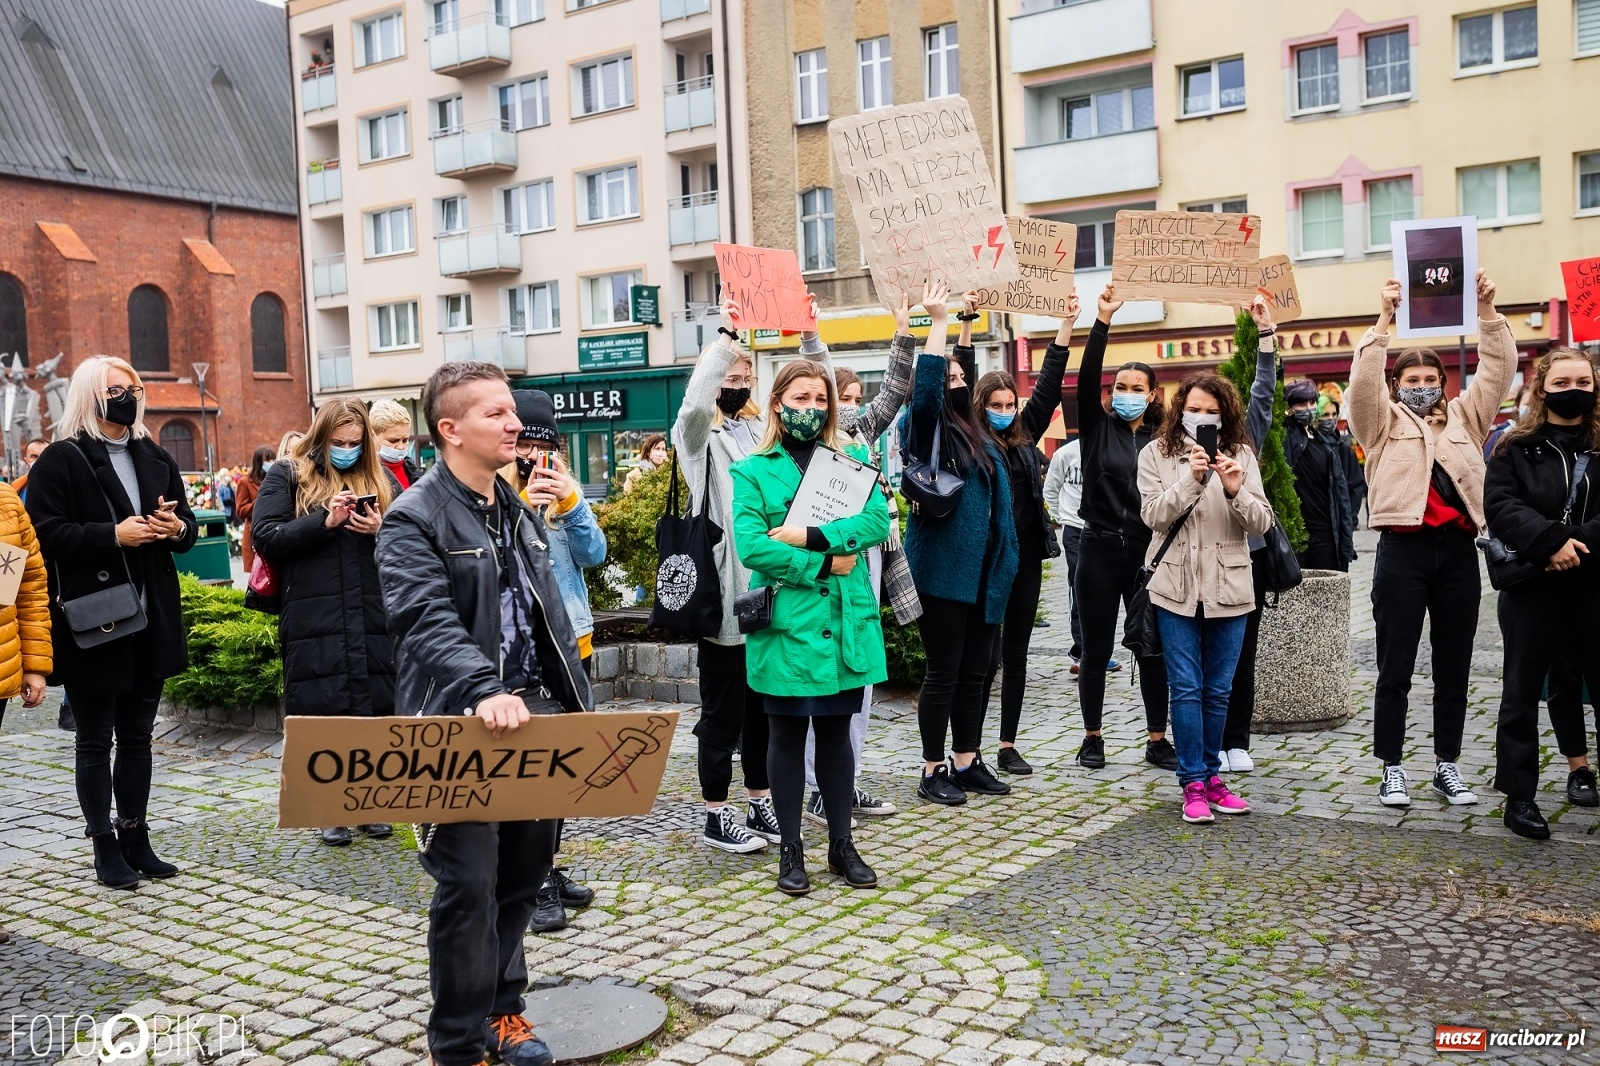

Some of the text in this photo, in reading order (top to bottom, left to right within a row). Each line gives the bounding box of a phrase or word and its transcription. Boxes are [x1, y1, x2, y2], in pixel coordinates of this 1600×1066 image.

[843, 108, 970, 167] MEFEDRON
[855, 152, 977, 204] MA LEPSZY
[869, 181, 992, 234] SKŁAD NIŻ
[886, 214, 986, 259] POLSKI
[1018, 218, 1058, 238] MACIE
[1129, 217, 1229, 236] WALCZCIE Z
[1014, 241, 1047, 258] ENIA
[1133, 239, 1243, 260] WIRUSEM, NIE
[722, 251, 769, 290] MOJE
[1019, 262, 1058, 283] ZAJĄC
[1126, 264, 1249, 288] Z KOBIETAMI
[1259, 261, 1288, 286] JEST
[1007, 279, 1032, 294] NAS
[977, 288, 1066, 312] DO RODZENIA
[909, 316, 932, 326] TEFCZ
[1181, 330, 1350, 357] RESTRACJA
[553, 390, 622, 410] BILER
[811, 504, 821, 513] NIE
[815, 490, 848, 508] MOJA CIPKA
[811, 513, 831, 523] BROSZ
[388, 720, 464, 749] STOP
[306, 746, 585, 784] OBOWIĄZEK
[342, 781, 492, 811] SZCZEPIEŃ
